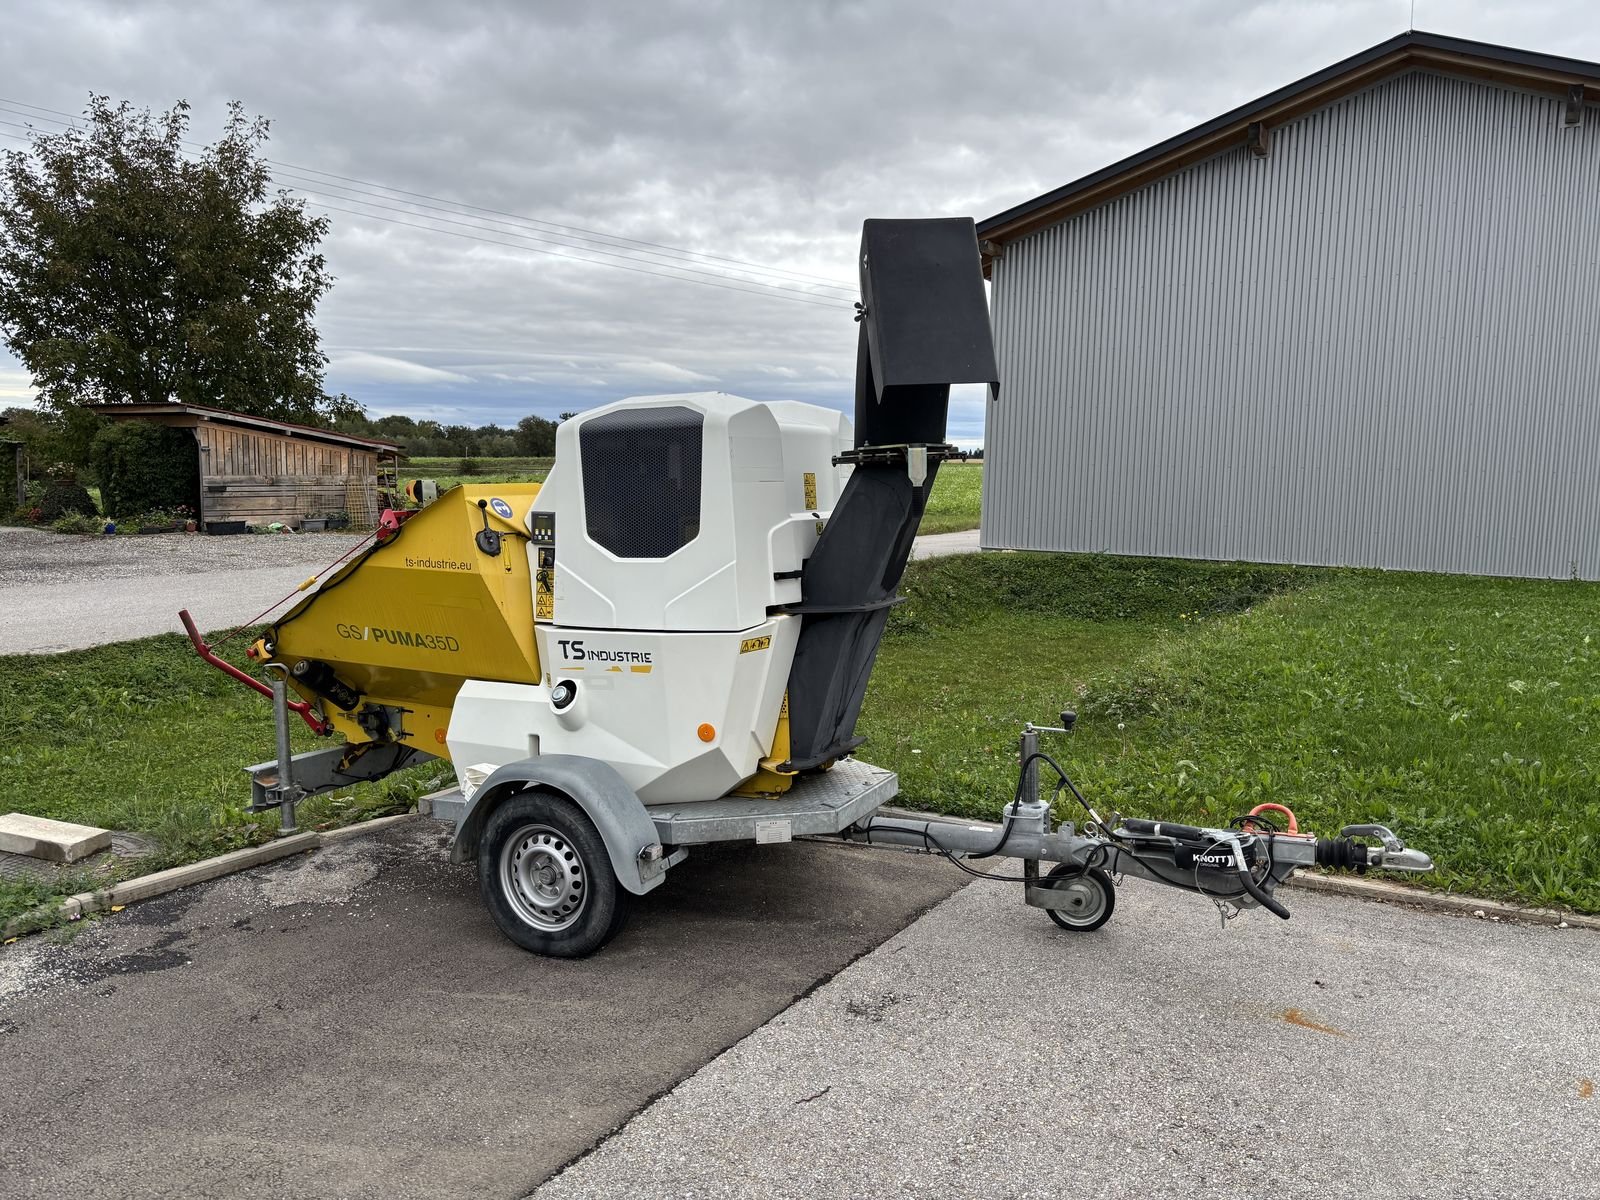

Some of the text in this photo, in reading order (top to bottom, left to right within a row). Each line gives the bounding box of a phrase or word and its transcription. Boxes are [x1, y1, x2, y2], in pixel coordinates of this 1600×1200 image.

[405, 556, 472, 570] ts-industrie.eu
[558, 640, 652, 663] TS INDUSTRIE
[1192, 853, 1227, 863] KNOTT
